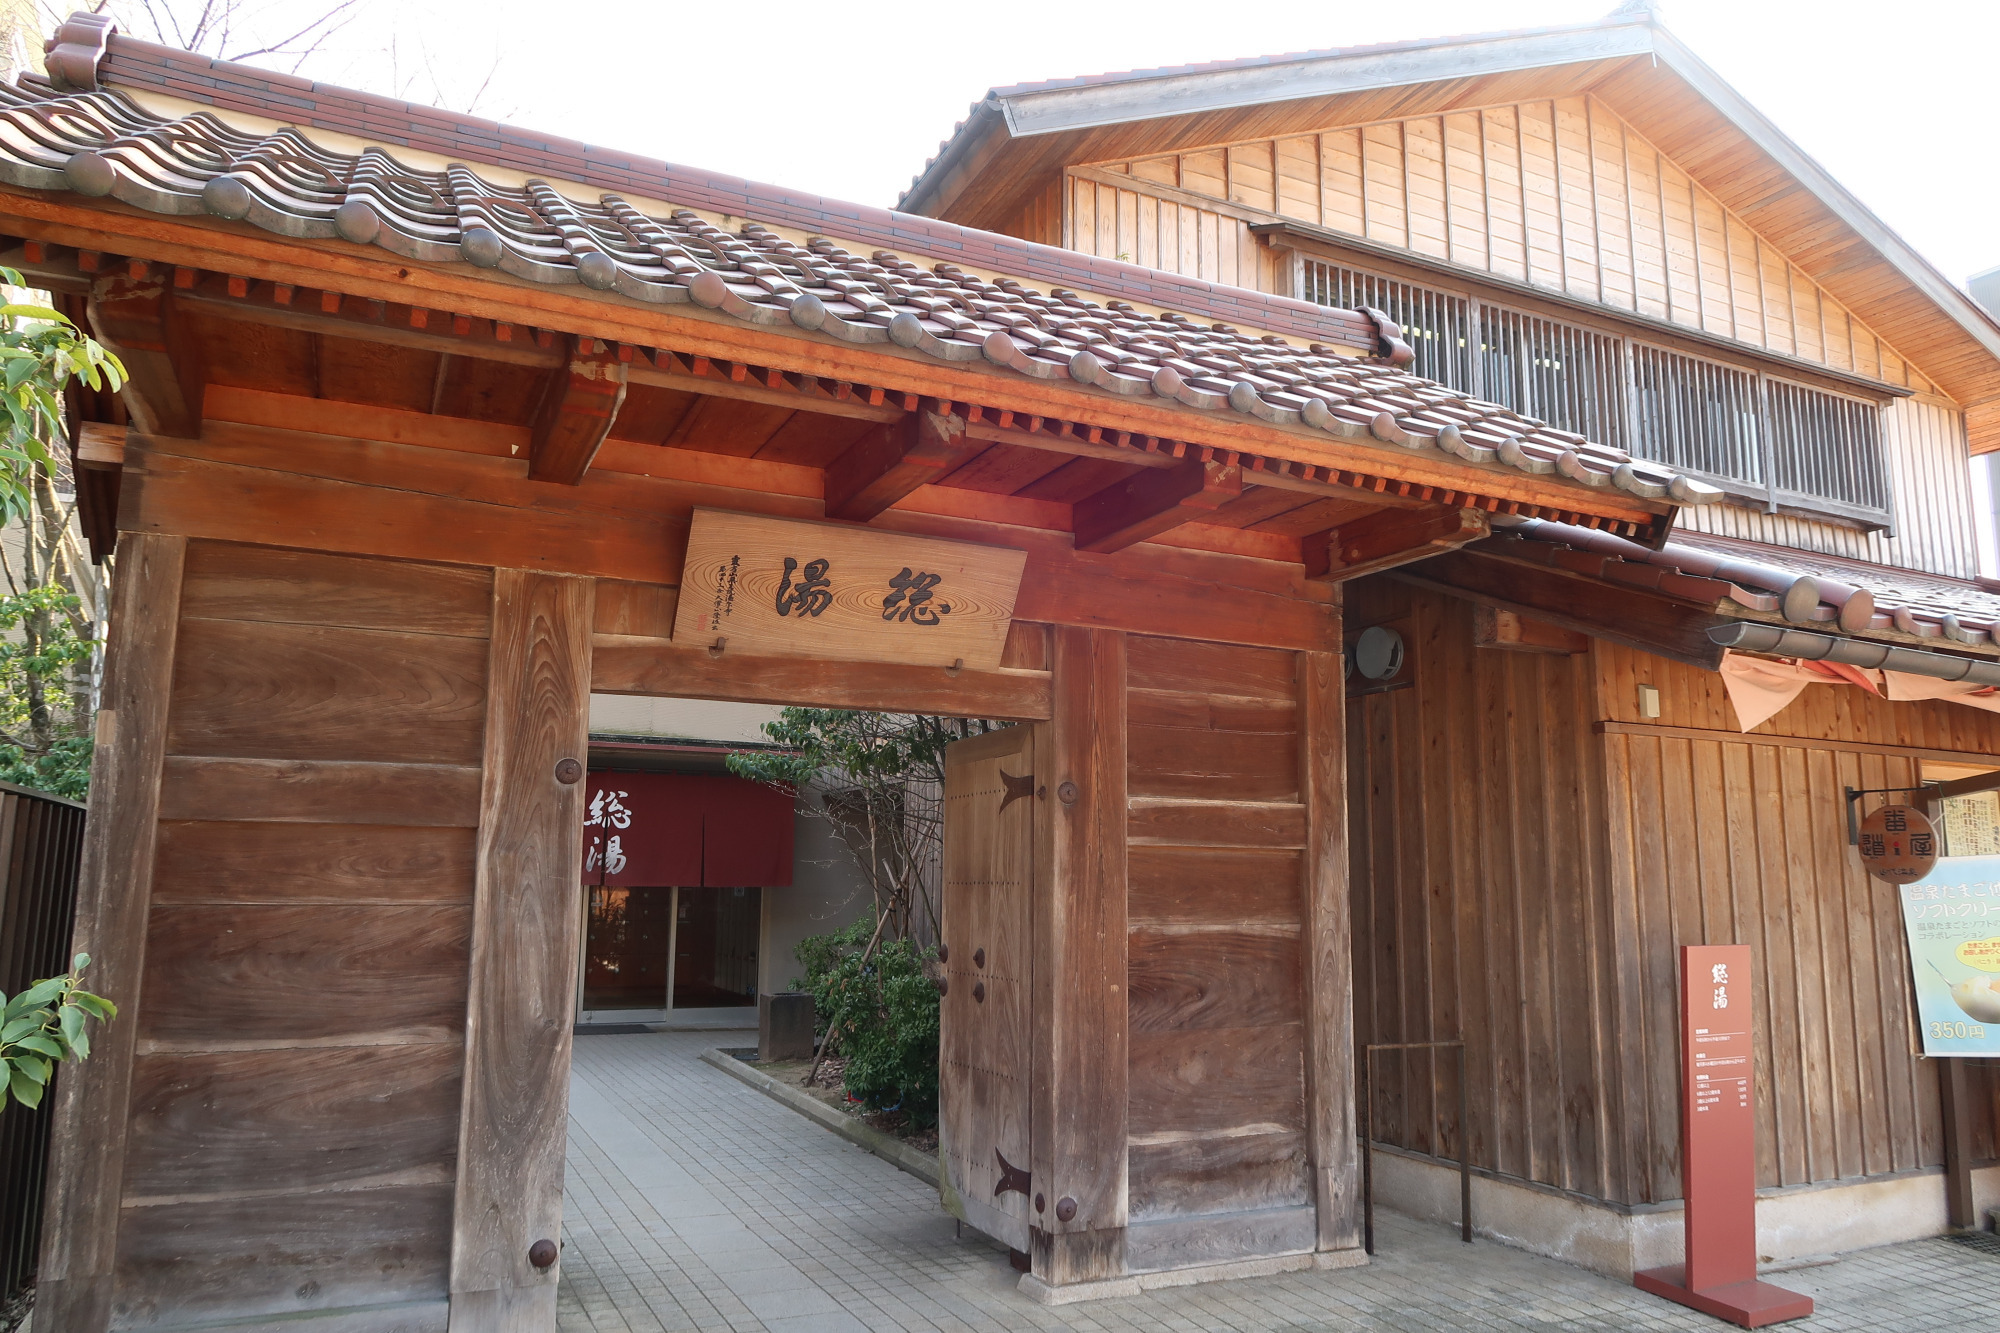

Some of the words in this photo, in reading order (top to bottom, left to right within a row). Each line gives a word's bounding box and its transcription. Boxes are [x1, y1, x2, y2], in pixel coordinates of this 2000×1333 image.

[583, 788, 632, 875] 総湯
[1918, 930, 1986, 940] コラボレーション
[1711, 963, 1729, 1009] 総湯
[1929, 1021, 1986, 1039] 350円
